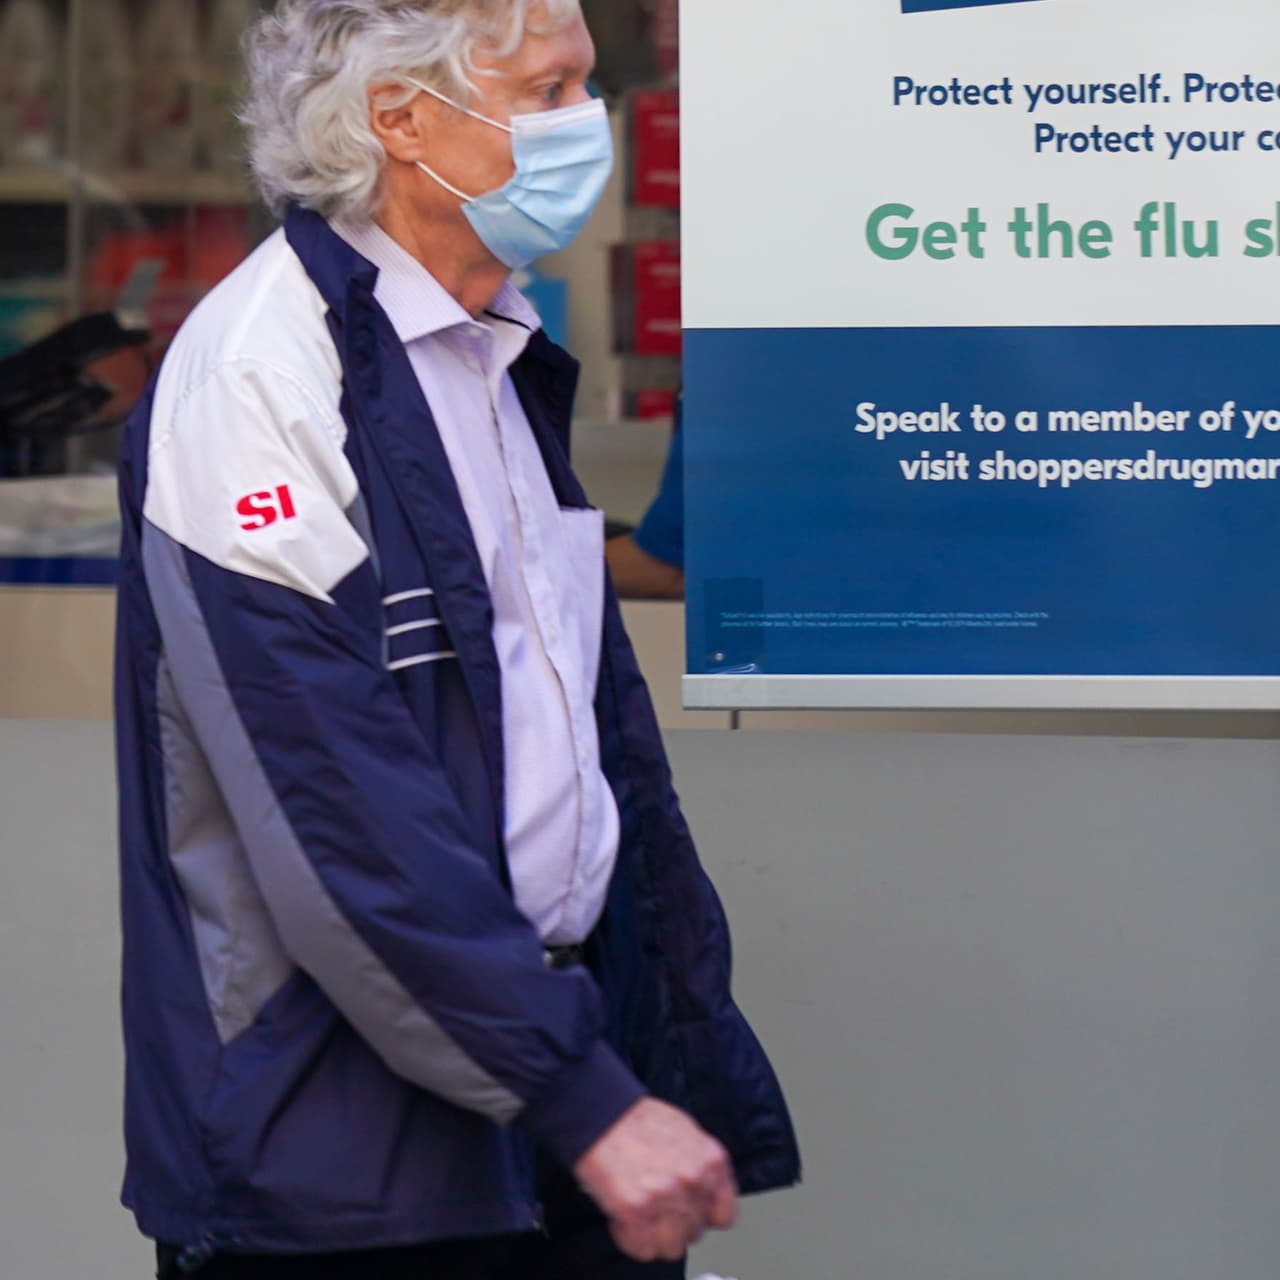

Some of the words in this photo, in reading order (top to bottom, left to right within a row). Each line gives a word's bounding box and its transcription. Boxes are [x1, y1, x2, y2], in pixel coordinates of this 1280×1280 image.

[892, 74, 1013, 108] Protect
[1024, 71, 1170, 113] yourself.
[1034, 122, 1154, 154] Protect
[1165, 126, 1246, 160] your
[865, 202, 987, 261] Get
[1007, 202, 1113, 259] the
[1133, 201, 1220, 258] flu
[854, 401, 961, 441] Speak
[970, 403, 1006, 433] to
[1014, 410, 1038, 433] a
[1048, 401, 1189, 433] member
[1198, 400, 1236, 432] of
[899, 450, 970, 481] visit
[236, 484, 296, 531] SI
